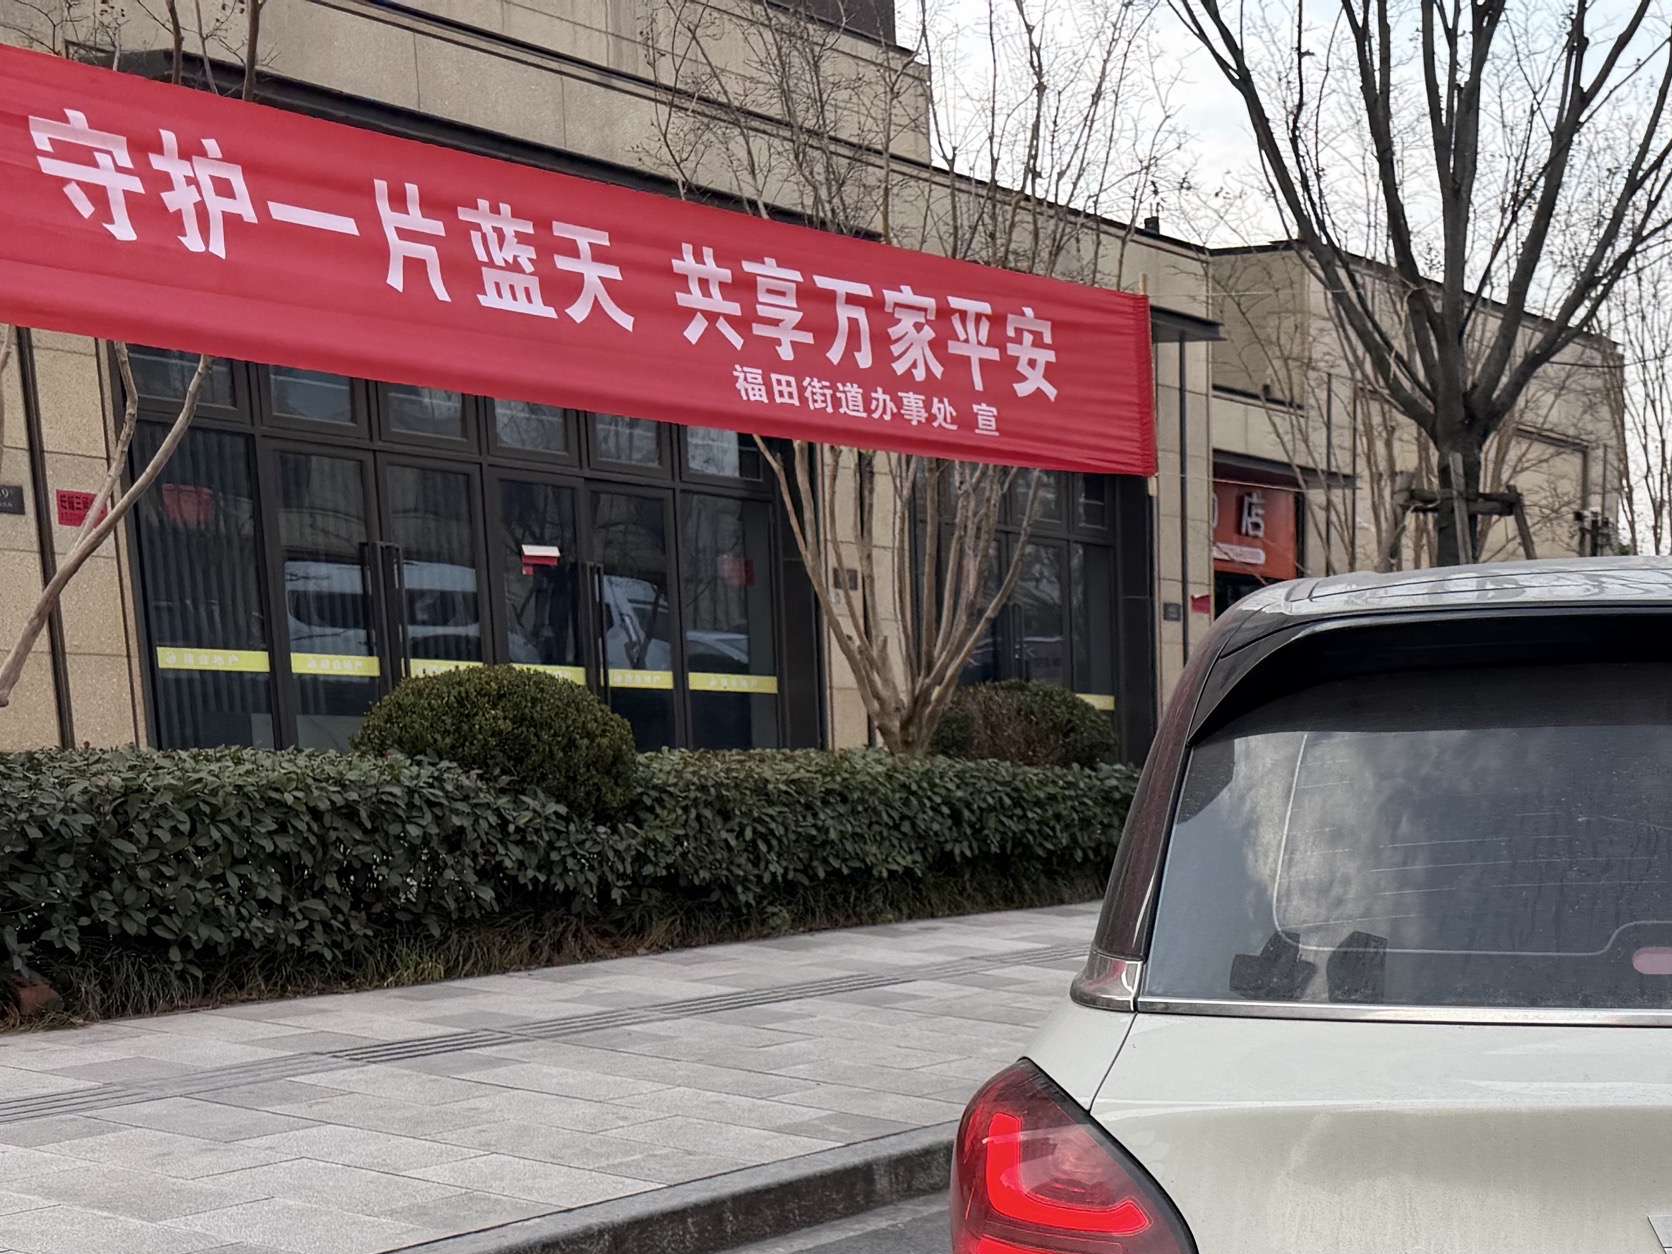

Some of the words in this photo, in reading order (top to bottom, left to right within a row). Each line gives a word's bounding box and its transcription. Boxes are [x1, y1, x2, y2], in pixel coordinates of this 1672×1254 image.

[28, 108, 635, 333] 守护一片蓝天
[671, 242, 1058, 402] 共享万家平安
[733, 363, 958, 431] 福田街道办事处
[972, 403, 1000, 437] 宣
